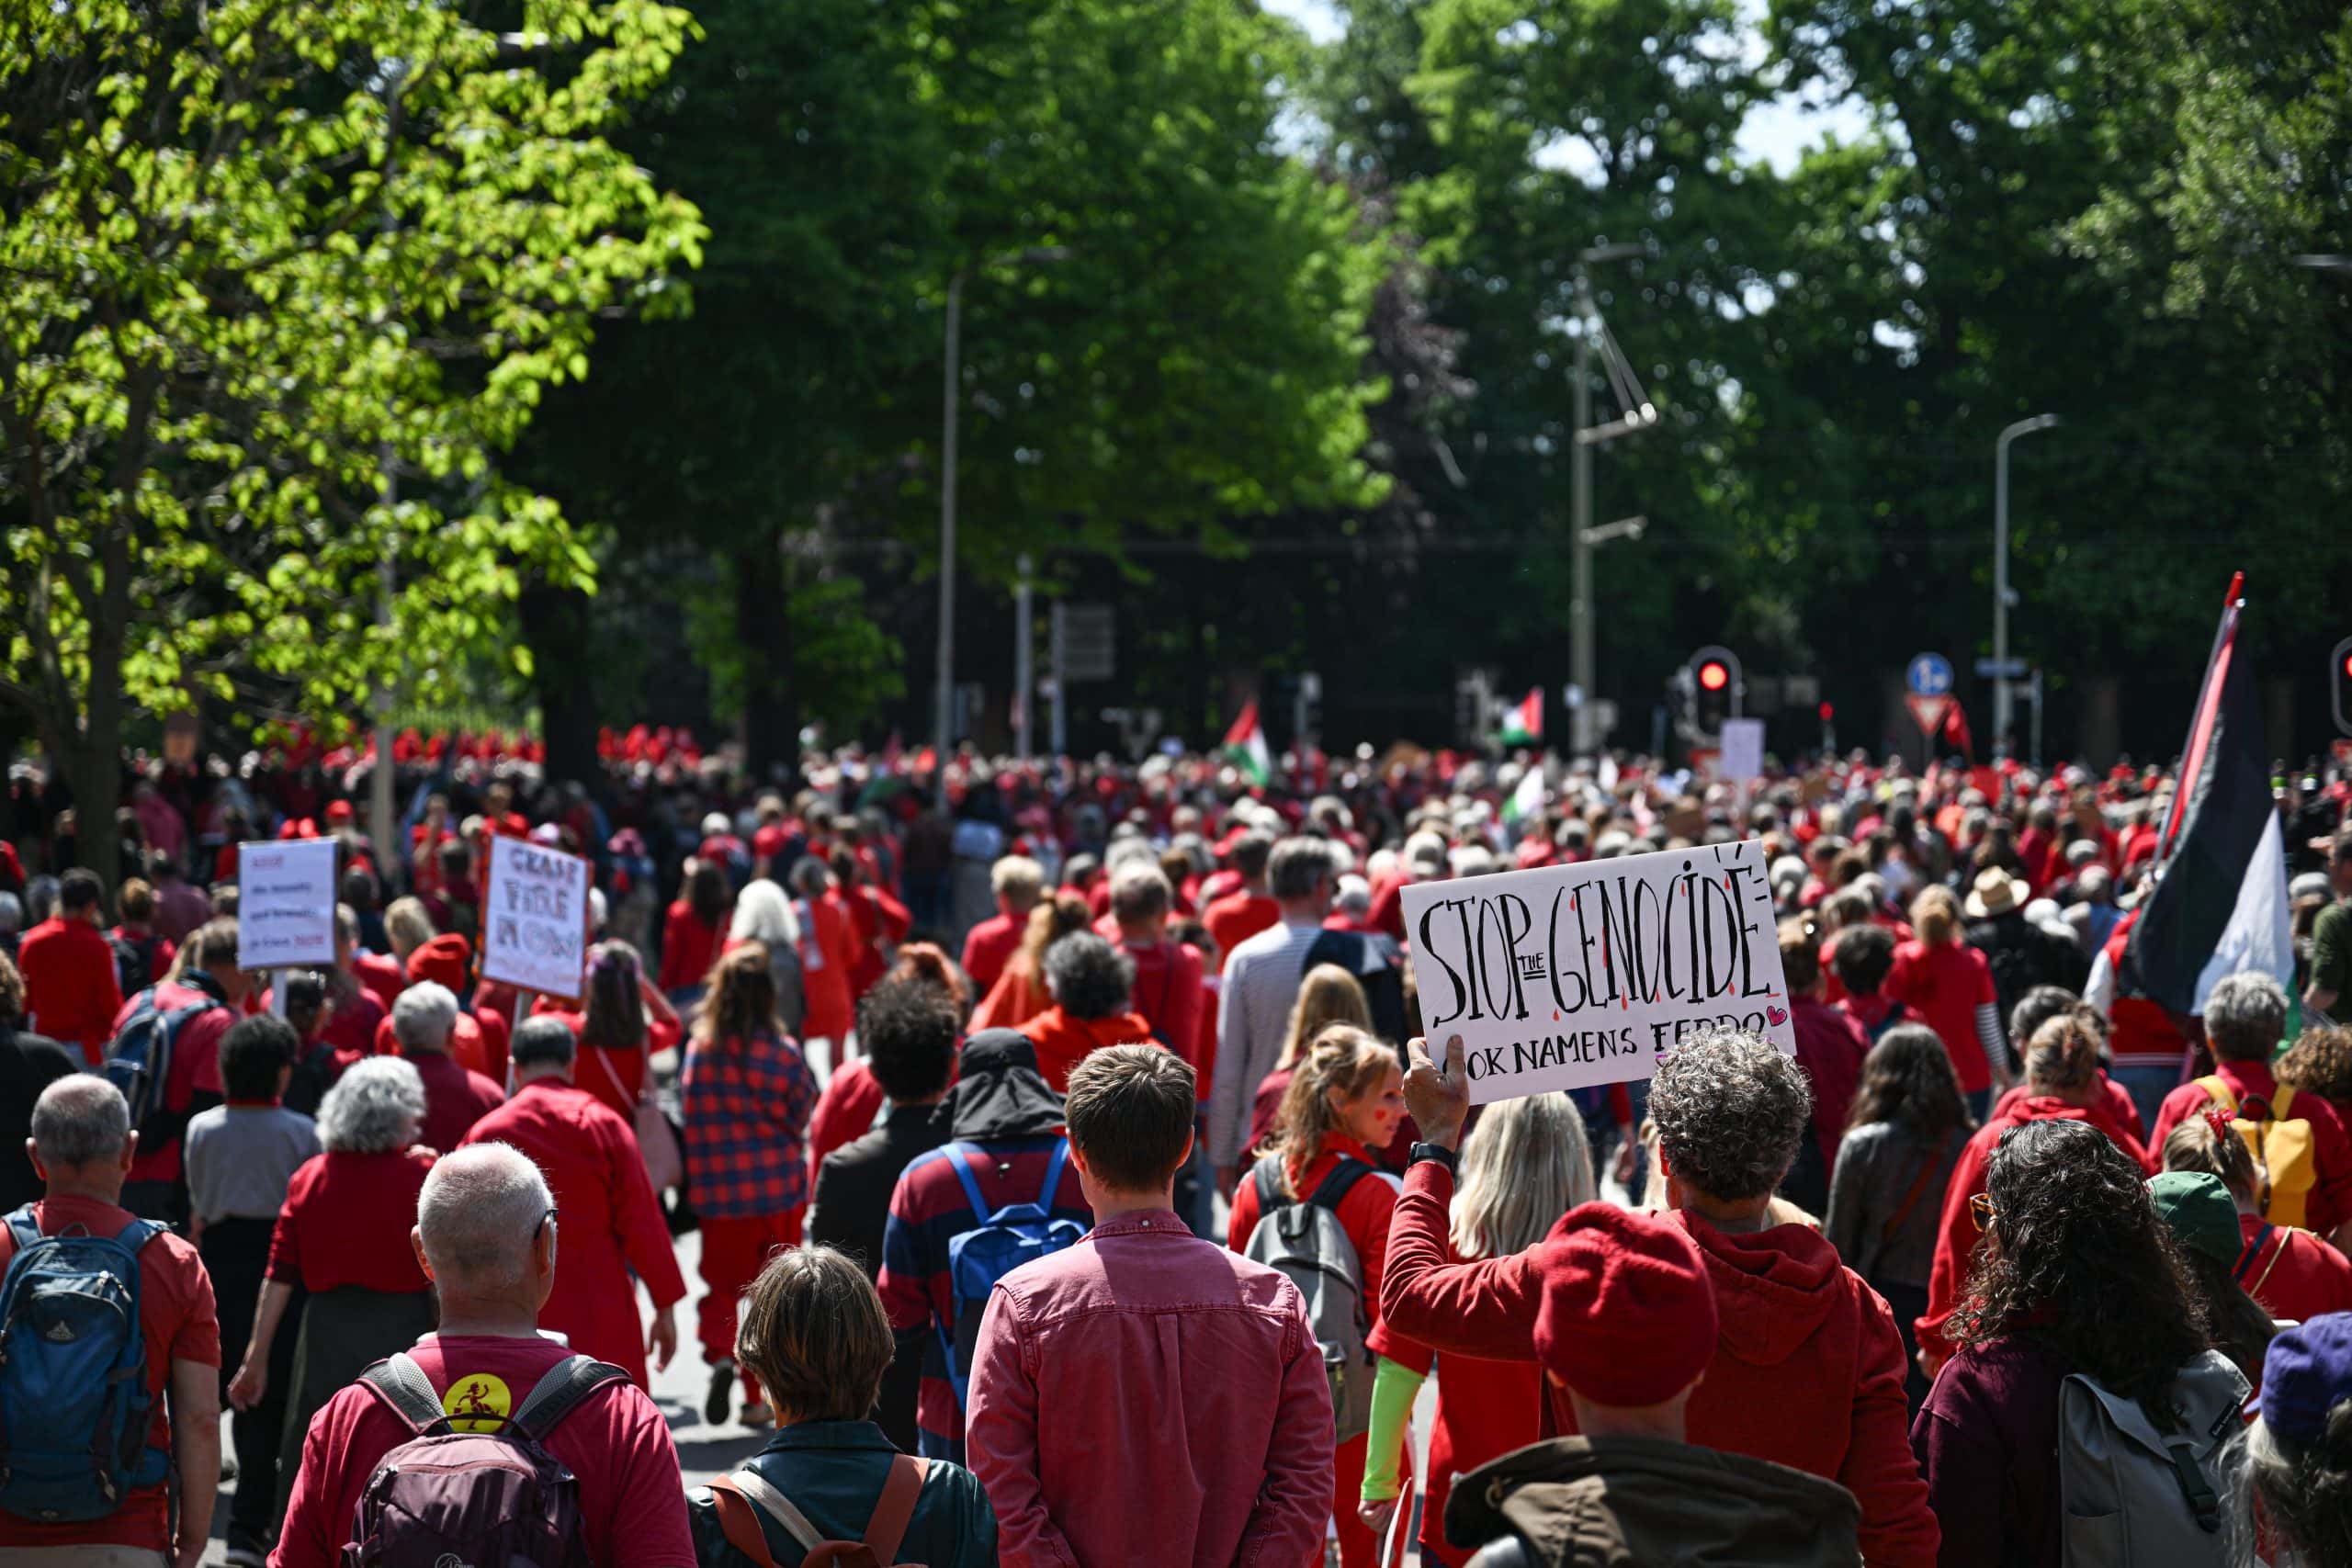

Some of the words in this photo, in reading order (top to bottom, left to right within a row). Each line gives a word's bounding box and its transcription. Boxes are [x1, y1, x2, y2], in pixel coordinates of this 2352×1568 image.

[509, 847, 579, 885] CEASE
[503, 877, 569, 921] FIRE
[496, 914, 579, 960] NOW
[1419, 893, 1532, 1028] STOP
[1517, 952, 1544, 971] THE
[1549, 860, 1771, 1013] GENOCIDE
[1512, 1026, 1638, 1074] NAMENS
